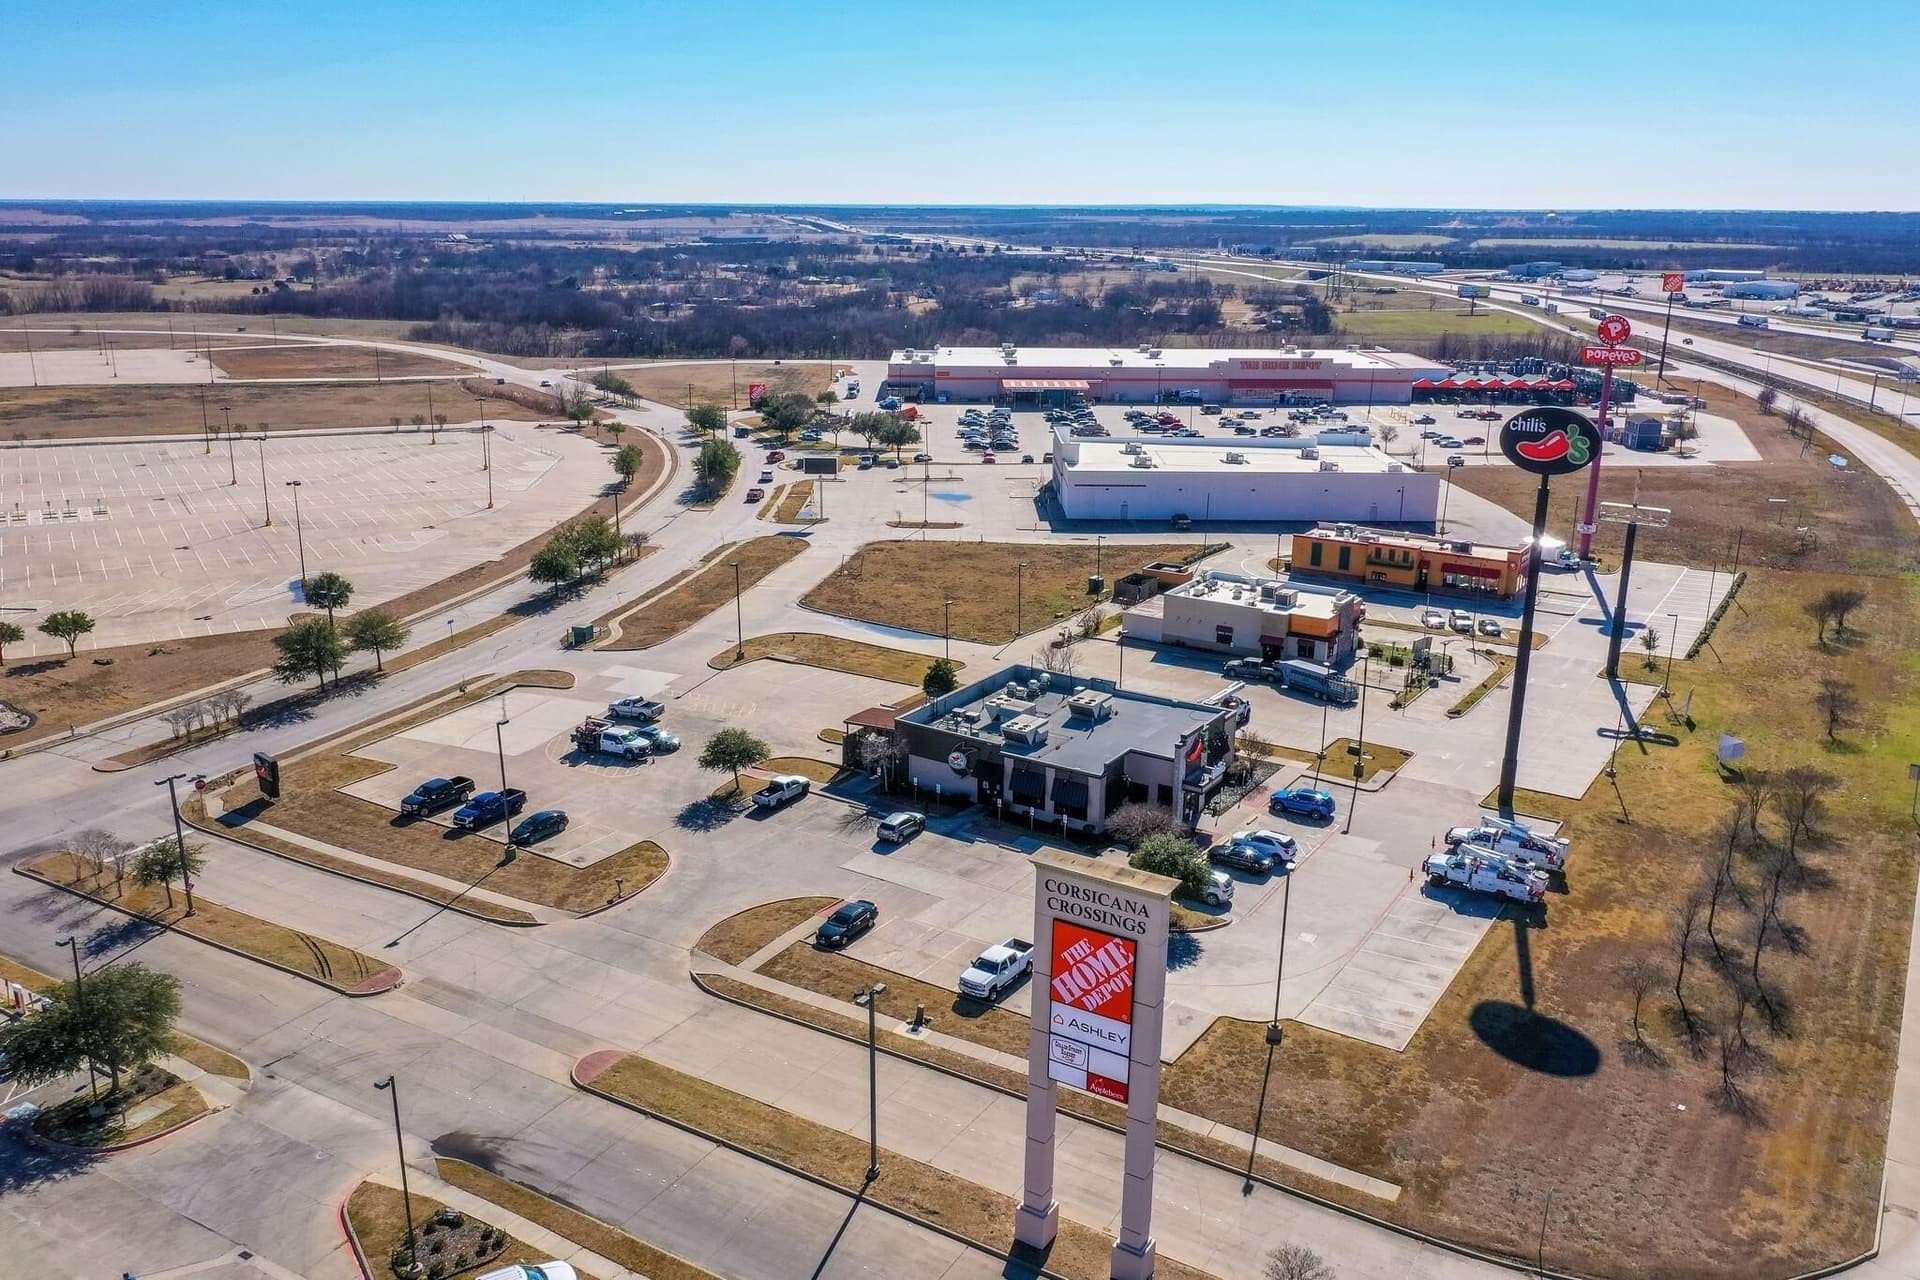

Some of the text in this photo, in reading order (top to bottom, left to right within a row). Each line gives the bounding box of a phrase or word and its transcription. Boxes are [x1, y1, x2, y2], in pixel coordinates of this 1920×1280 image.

[1586, 350, 1637, 361] POPeYeS
[1510, 417, 1547, 433] chili's
[1045, 879, 1150, 918] CORSICANA
[1047, 897, 1146, 934] CROSSINGS
[1061, 938, 1094, 966] THE
[1052, 938, 1134, 1004] HOME
[1081, 970, 1133, 1011] DEPOT
[1068, 1019, 1127, 1044] ASHLEY
